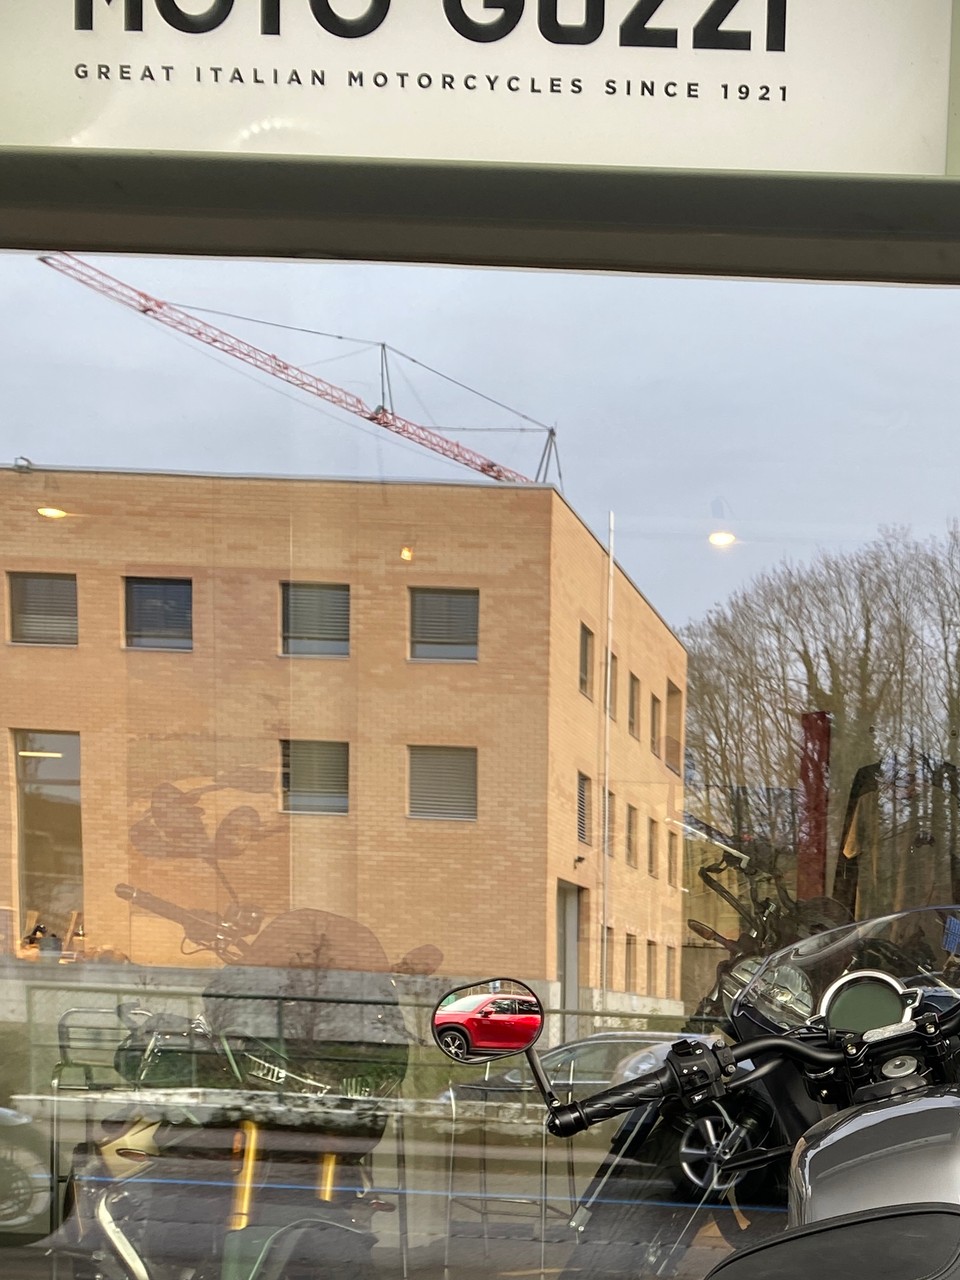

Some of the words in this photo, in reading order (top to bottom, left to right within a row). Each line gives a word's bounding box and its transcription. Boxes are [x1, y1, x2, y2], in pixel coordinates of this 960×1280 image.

[74, 63, 174, 81] GREAT
[196, 67, 325, 86] ITALIAN
[348, 71, 583, 94] MOTORCYCLES
[605, 79, 699, 99] SINCE
[721, 83, 787, 102] 1921
